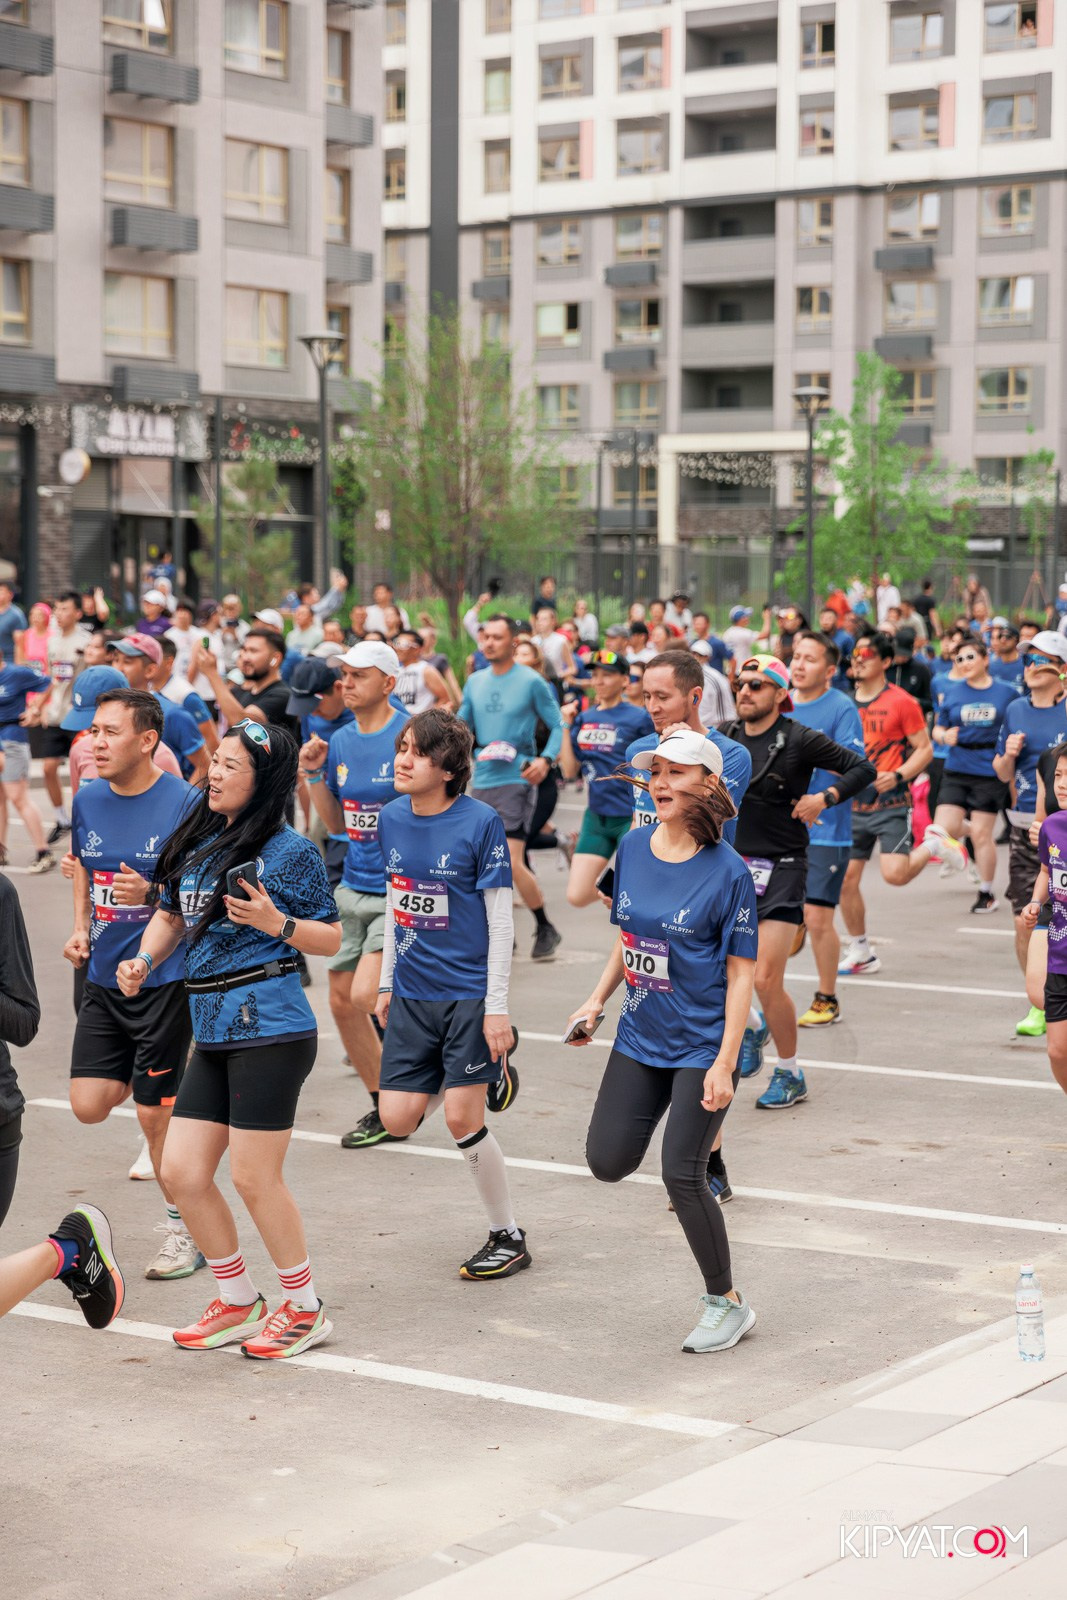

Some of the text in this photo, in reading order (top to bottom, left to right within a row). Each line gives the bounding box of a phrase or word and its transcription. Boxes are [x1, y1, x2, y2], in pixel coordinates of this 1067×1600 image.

[351, 813, 377, 828] 362
[399, 894, 435, 914] 458
[625, 950, 656, 975] 010
